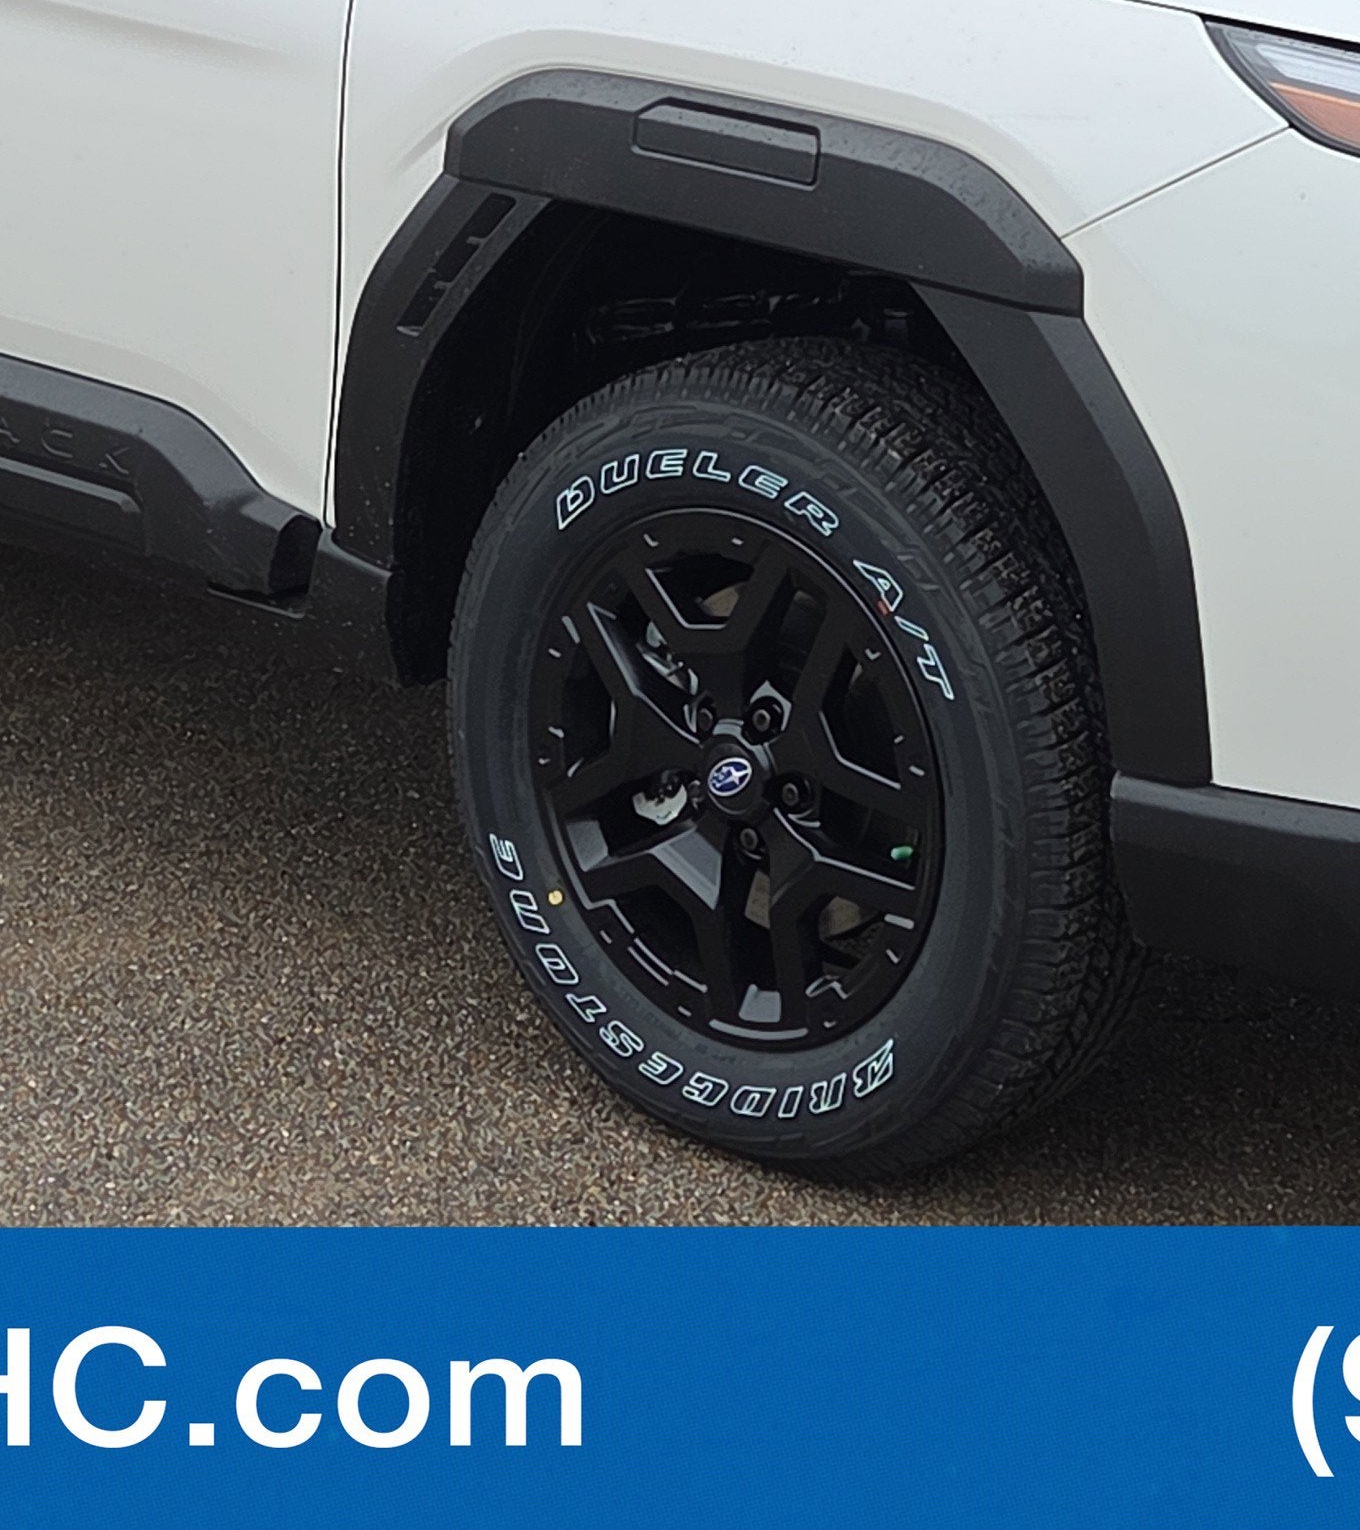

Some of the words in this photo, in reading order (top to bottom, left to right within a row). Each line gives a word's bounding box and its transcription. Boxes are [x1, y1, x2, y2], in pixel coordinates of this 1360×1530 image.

[556, 447, 841, 532] DUELER
[852, 558, 956, 702] A/T
[488, 831, 896, 1120] BRIDGESTONE
